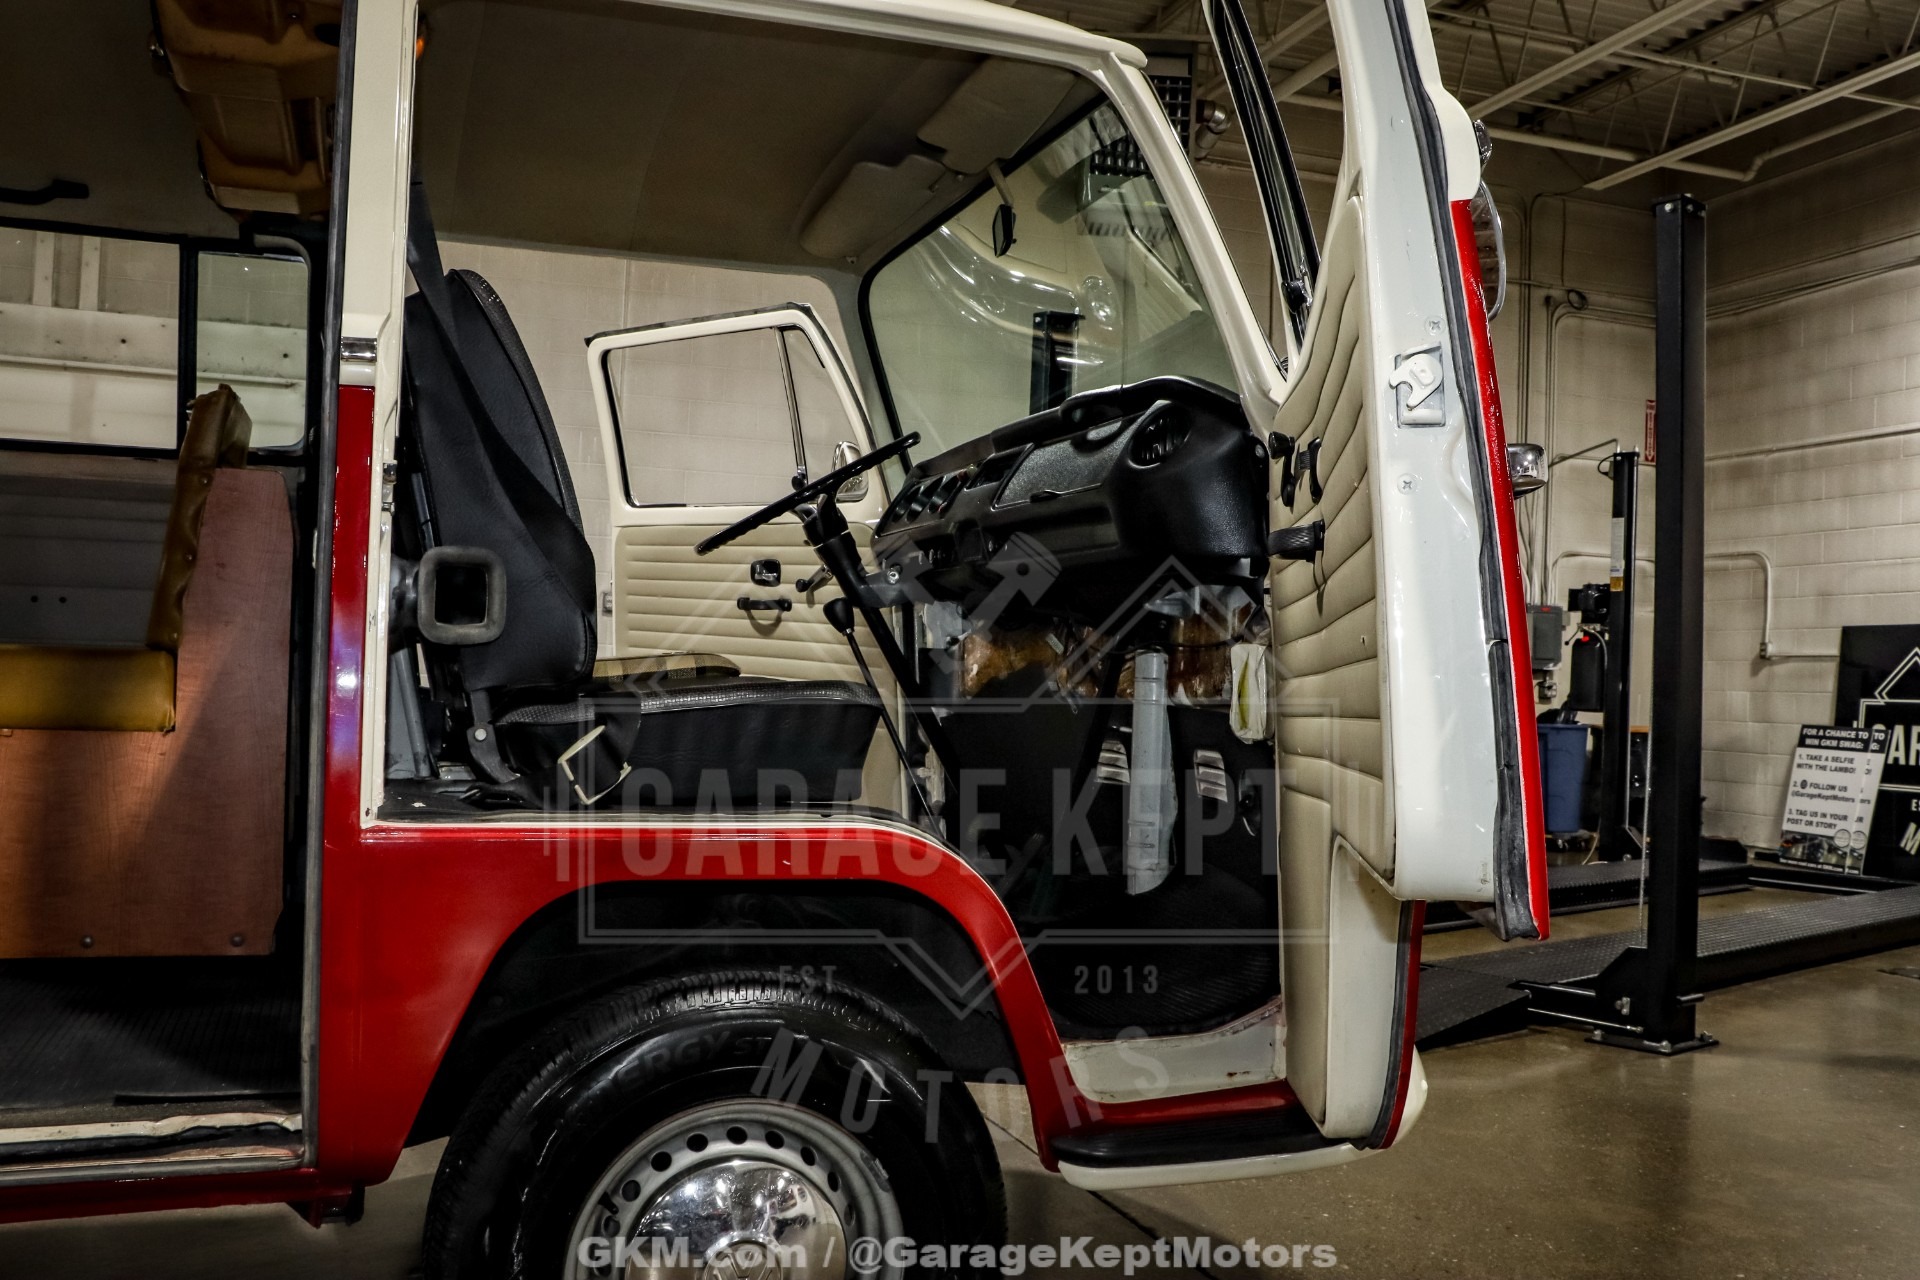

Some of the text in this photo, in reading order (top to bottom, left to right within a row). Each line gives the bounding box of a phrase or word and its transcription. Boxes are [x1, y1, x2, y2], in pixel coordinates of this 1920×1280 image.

[1802, 728, 1869, 740] FOR A CHANCE TO
[1805, 738, 1819, 746] WIN
[1820, 739, 1838, 747] GKM
[1839, 740, 1864, 749] SWAG:
[1806, 754, 1823, 762] TAKE
[1831, 756, 1855, 764] SELFIE
[1815, 764, 1828, 772] THE
[1829, 765, 1857, 774] LAMBO!
[1809, 782, 1837, 791] FOLLOW
[1838, 785, 1848, 793] US
[1791, 790, 1856, 803] @GarageKeptMotors
[1829, 813, 1849, 821] YOUR
[1786, 817, 1803, 825] POST
[1815, 821, 1838, 829] STORY
